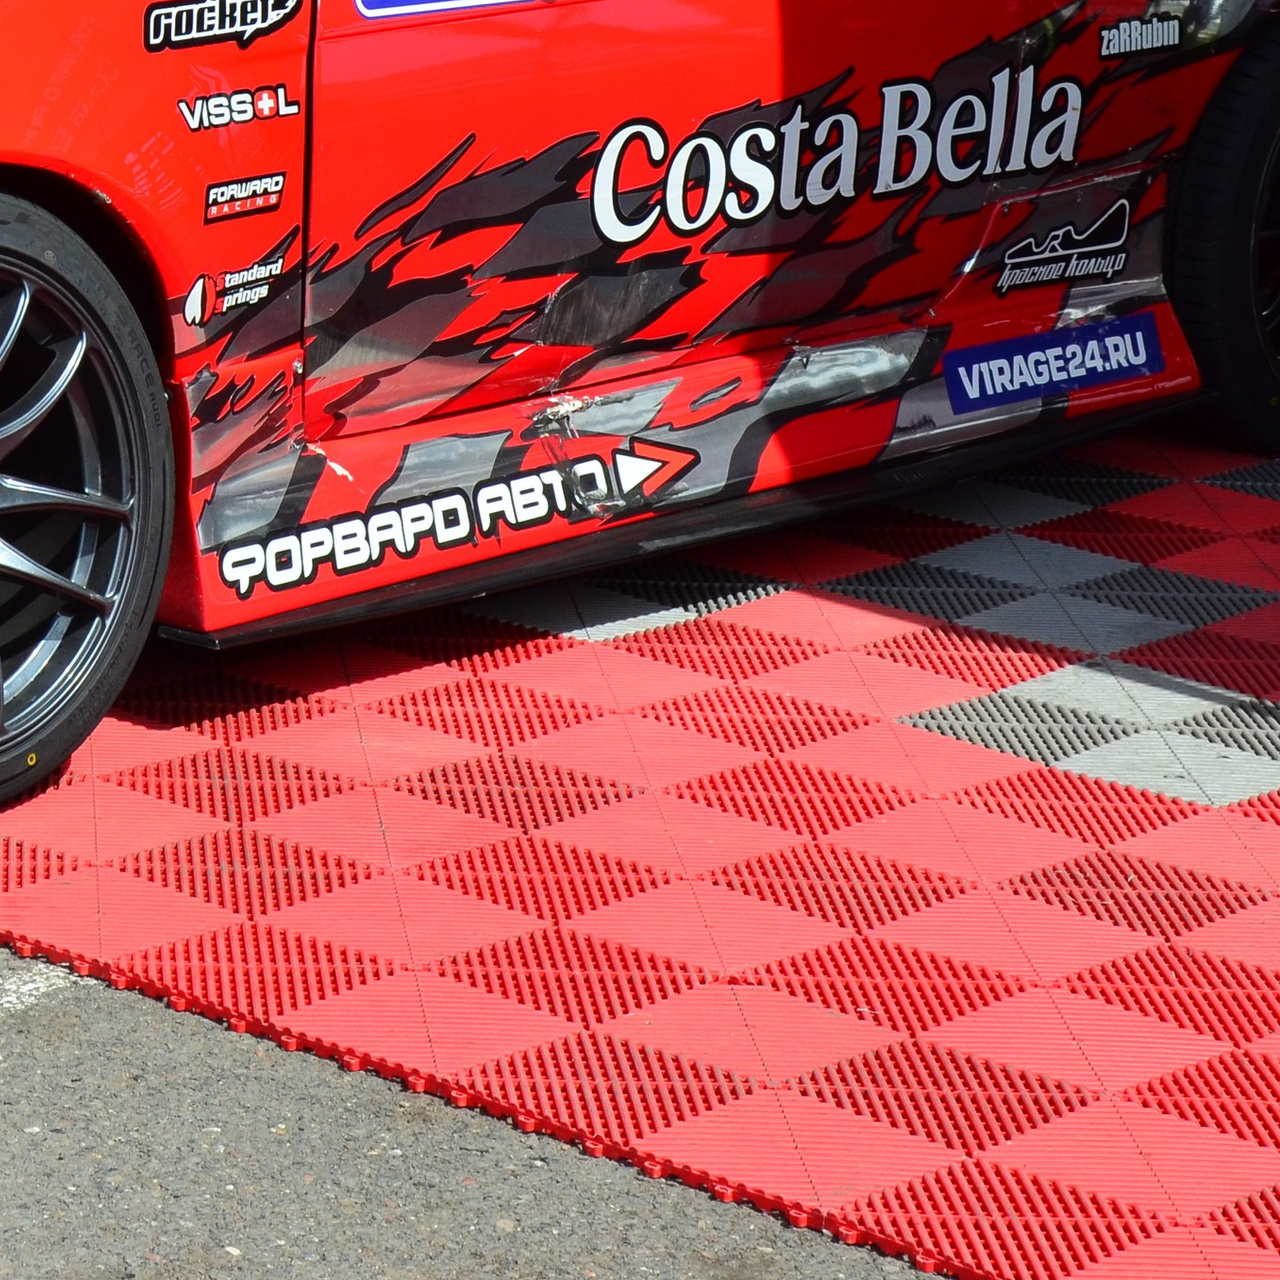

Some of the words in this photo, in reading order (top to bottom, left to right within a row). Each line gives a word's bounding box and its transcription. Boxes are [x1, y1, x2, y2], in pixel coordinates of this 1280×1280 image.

[593, 104, 858, 243] Costa
[873, 64, 1083, 195] Bella
[209, 175, 284, 205] FORWARD
[211, 195, 277, 216] RACING
[216, 258, 283, 291] Standard
[957, 331, 1148, 400] VIRAGE24.RU
